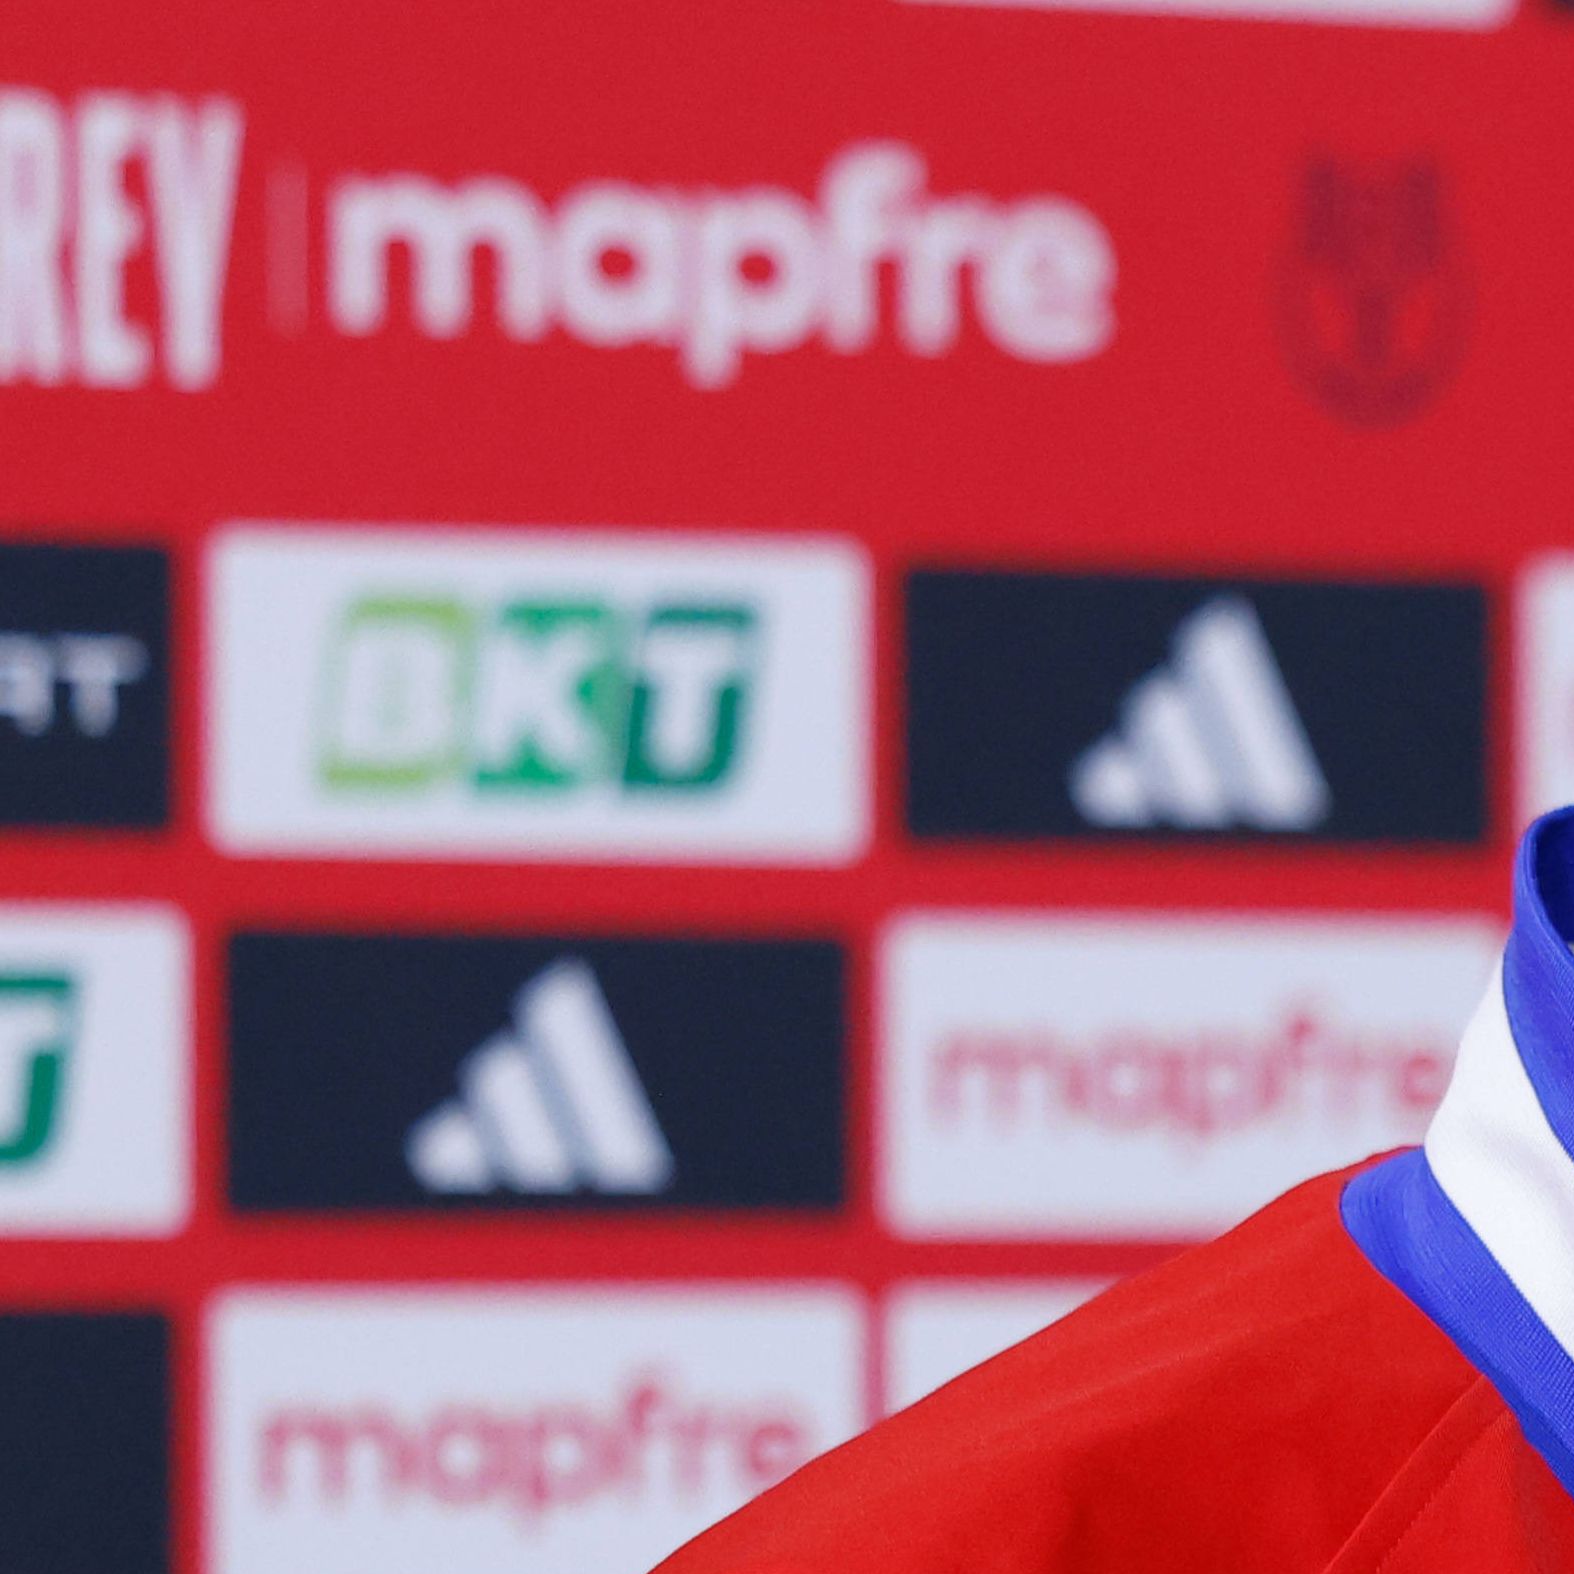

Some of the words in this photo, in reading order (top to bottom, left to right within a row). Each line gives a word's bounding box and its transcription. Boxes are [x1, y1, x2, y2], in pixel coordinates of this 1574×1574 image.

[0, 88, 244, 390] REY
[326, 142, 1114, 388] mapfre
[312, 590, 758, 792] BKT
[928, 1003, 1455, 1155] mapfre
[257, 1370, 815, 1530] mapfre
